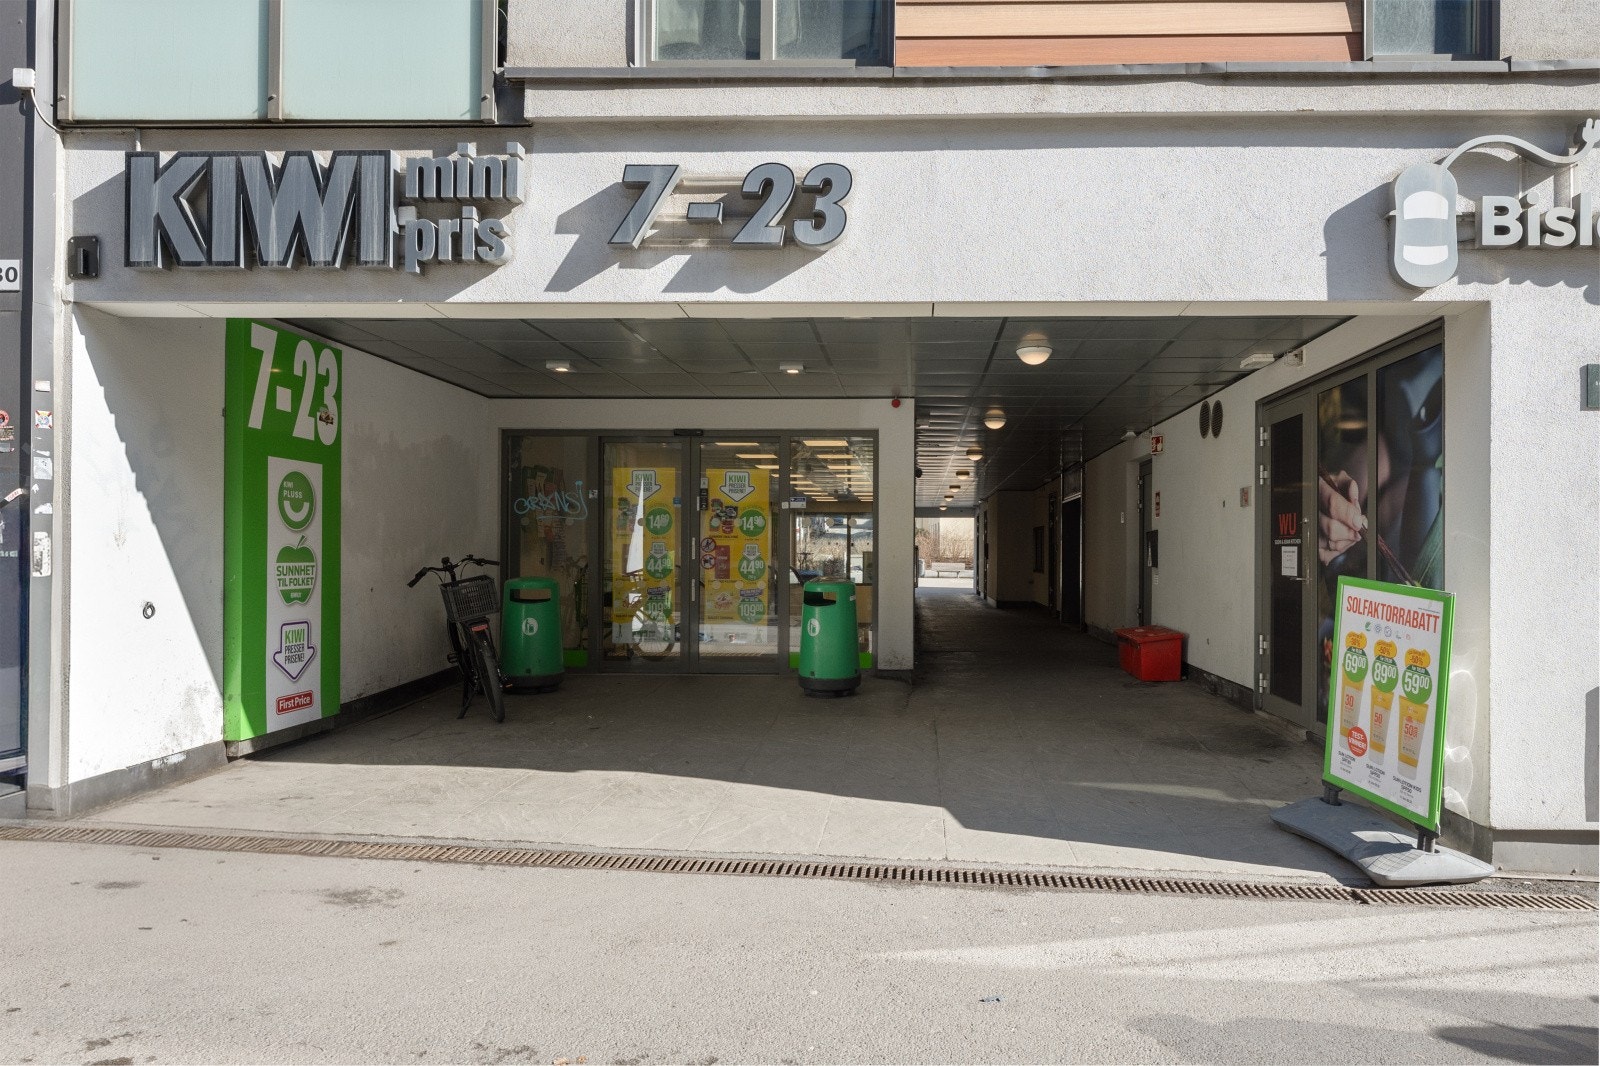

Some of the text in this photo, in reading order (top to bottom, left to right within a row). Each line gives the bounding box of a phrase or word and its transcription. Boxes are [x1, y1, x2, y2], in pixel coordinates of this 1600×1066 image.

[404, 142, 525, 203] mini
[124, 149, 398, 270] KIWI
[1480, 191, 1600, 248] Bisl
[403, 206, 512, 275] pris
[248, 322, 339, 446] 7-23
[728, 474, 747, 483] KIWI
[283, 489, 303, 499] PLUSS
[1279, 512, 1297, 535] WU
[276, 564, 316, 577] SUNNHET
[277, 576, 315, 587] TIL FOLKET
[1346, 595, 1440, 634] SOLFAKTORRABATT
[284, 628, 305, 643] KIWI
[284, 643, 305, 655] PRESSER
[284, 653, 305, 665] PRISENE!
[279, 695, 311, 711] First Price
